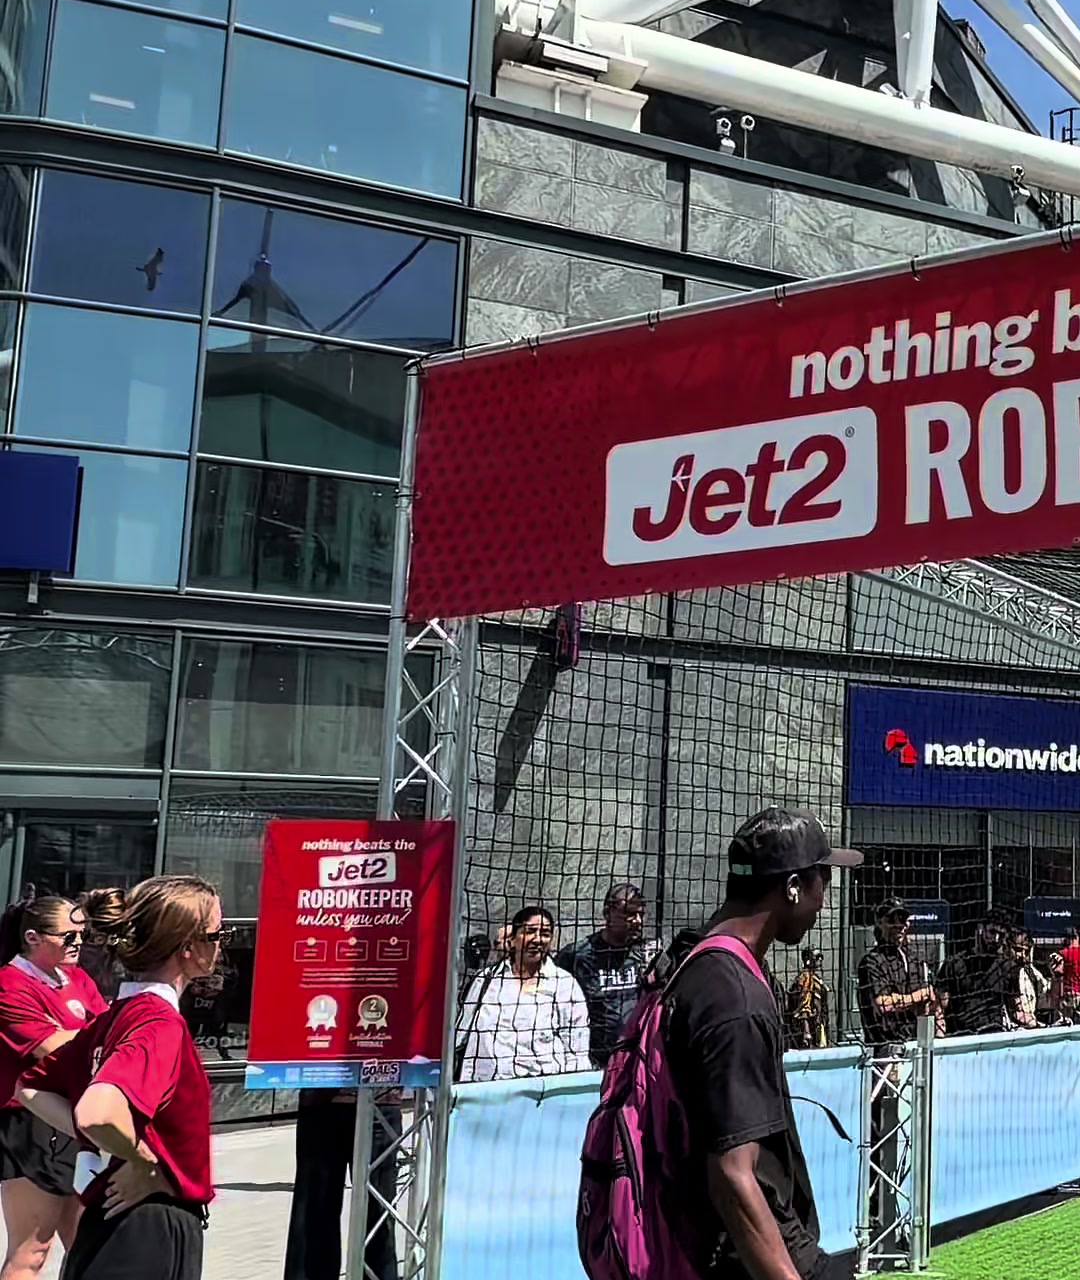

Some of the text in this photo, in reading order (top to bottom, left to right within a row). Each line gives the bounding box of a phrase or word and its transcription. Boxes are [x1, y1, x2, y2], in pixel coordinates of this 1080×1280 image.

[789, 312, 1039, 398] nothing
[632, 433, 847, 543] Jet2
[301, 838, 416, 853] nothing beats the
[327, 857, 388, 882] Jet2
[297, 889, 413, 909] ROBOKEEPER
[296, 908, 412, 932] unless you can?
